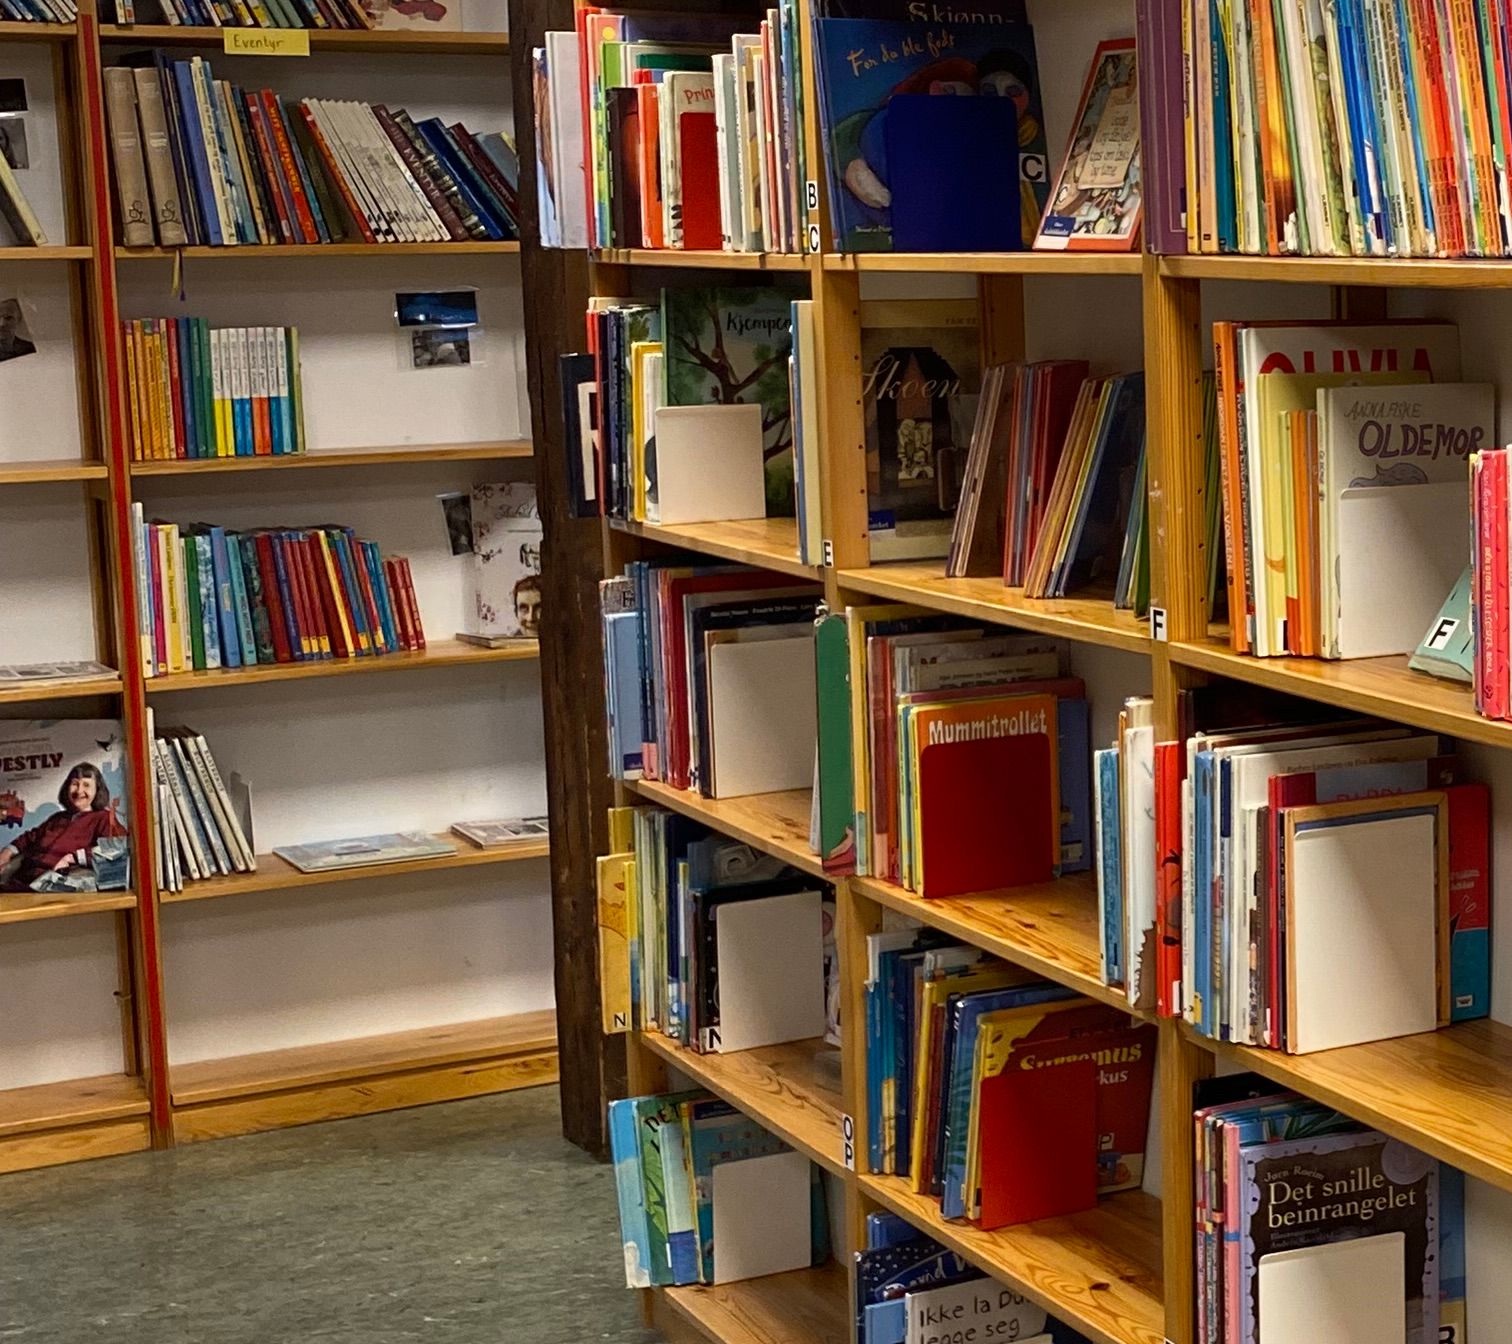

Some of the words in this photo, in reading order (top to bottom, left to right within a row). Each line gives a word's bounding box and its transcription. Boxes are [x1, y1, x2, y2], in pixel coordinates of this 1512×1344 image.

[233, 35, 284, 52] Eventyr
[1021, 155, 1043, 182] C
[808, 183, 818, 209] B
[810, 225, 820, 252] C
[863, 355, 961, 401] Skoen
[1358, 420, 1484, 462] OLDEMOR
[823, 541, 833, 567] E
[1152, 610, 1165, 640] F
[1428, 618, 1455, 648] F
[928, 708, 1047, 746] Mummitrollet
[0, 752, 64, 773] ESTLY
[614, 1012, 626, 1027] N
[843, 1116, 854, 1141] O
[844, 1142, 853, 1166] P
[1268, 1180, 1315, 1206] Det
[1322, 1166, 1384, 1198] snille
[1268, 1185, 1417, 1229] beinrangelet
[920, 1304, 965, 1328] Ikke
[973, 1294, 993, 1314] la
[999, 1290, 1033, 1310] Du
[985, 1316, 1020, 1343] seg
